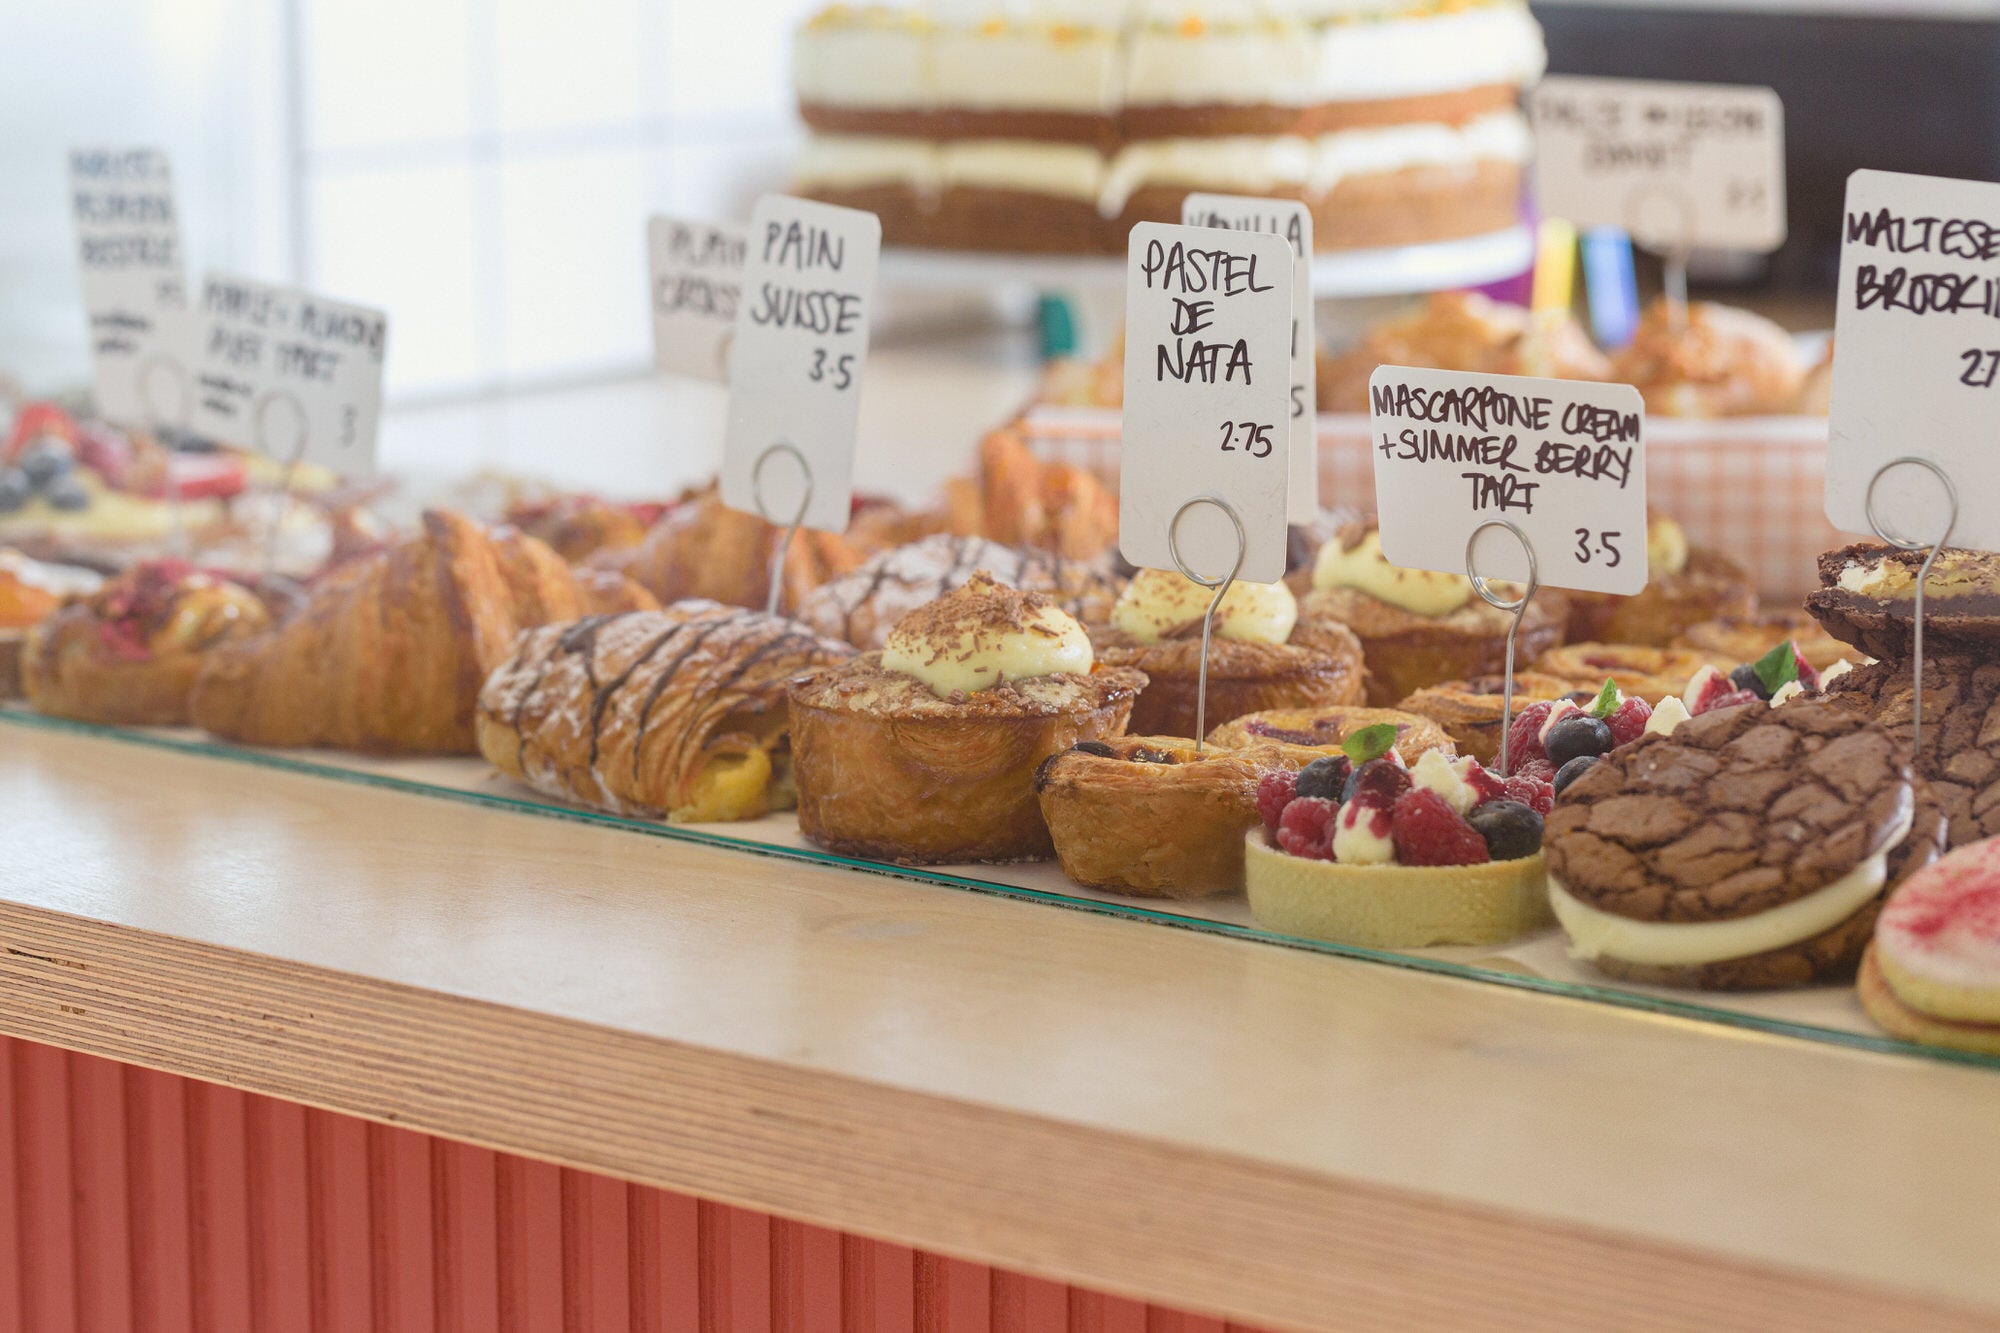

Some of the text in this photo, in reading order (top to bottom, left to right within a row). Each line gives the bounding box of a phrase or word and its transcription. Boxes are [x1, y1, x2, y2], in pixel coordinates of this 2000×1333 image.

[763, 219, 844, 271] PAIN
[1141, 239, 1274, 297] PASTEL
[751, 282, 862, 334] SUISSE
[1170, 297, 1215, 336] DE
[808, 347, 856, 392] 3.5
[1156, 337, 1253, 386] NATA
[1372, 383, 1640, 443] MASCARPONE CREAM
[1219, 420, 1274, 459] 2.75
[1535, 440, 1633, 489] BERRY
[1461, 472, 1540, 514] TART
[1574, 527, 1622, 568] 3.5
